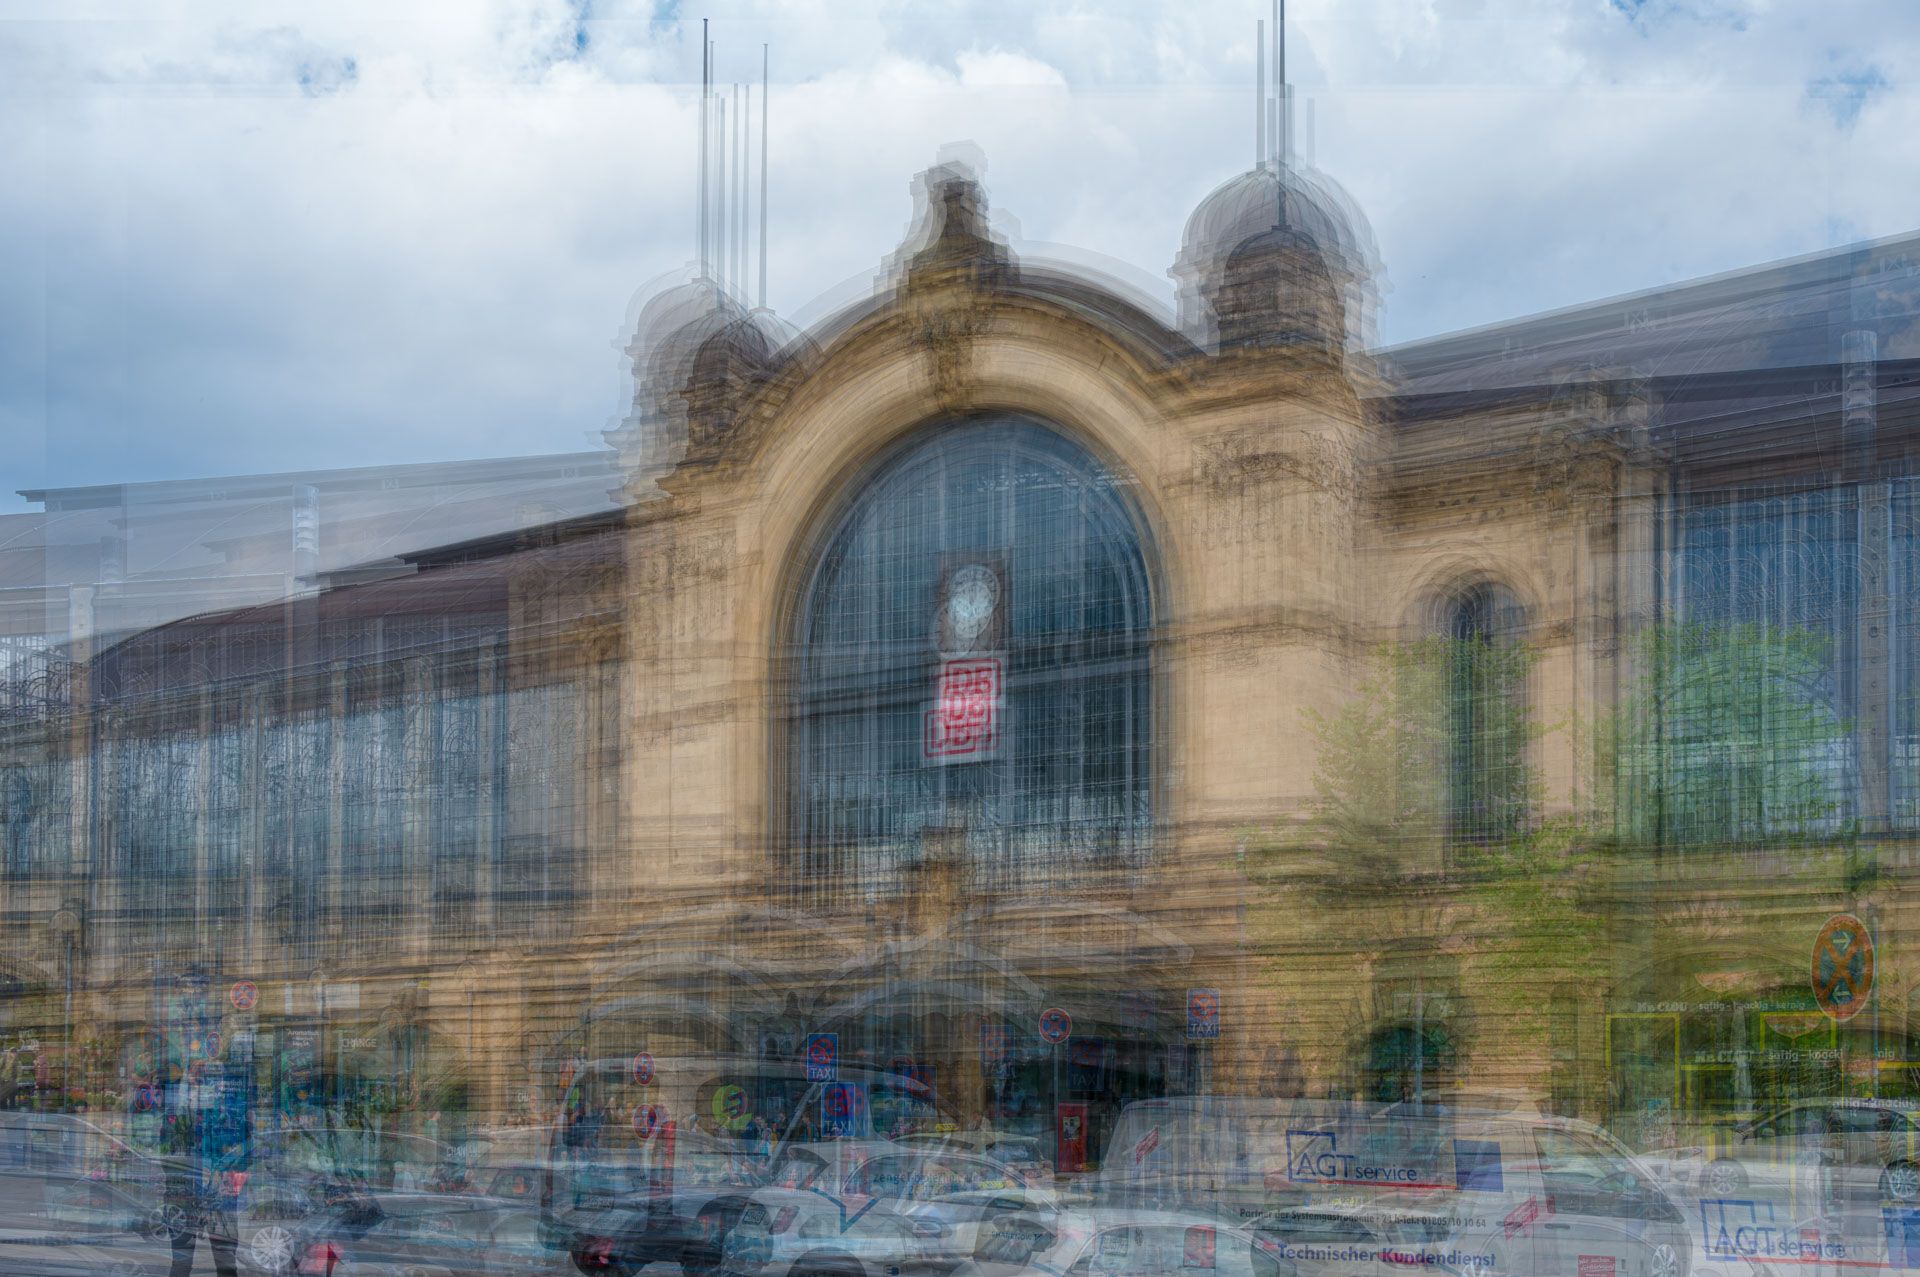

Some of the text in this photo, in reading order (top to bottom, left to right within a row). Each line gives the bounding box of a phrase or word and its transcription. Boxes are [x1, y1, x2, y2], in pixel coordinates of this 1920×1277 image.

[1191, 1023, 1216, 1035] TAXI
[811, 1067, 836, 1079] TAXI
[1072, 1073, 1100, 1085] TAXI
[908, 1102, 934, 1113] TAXI
[824, 1120, 852, 1132] TAXI
[1296, 1152, 1418, 1181] AGT service
[1476, 1218, 1486, 1228] 64
[1278, 1244, 1496, 1266] Technischer Kundendienst
